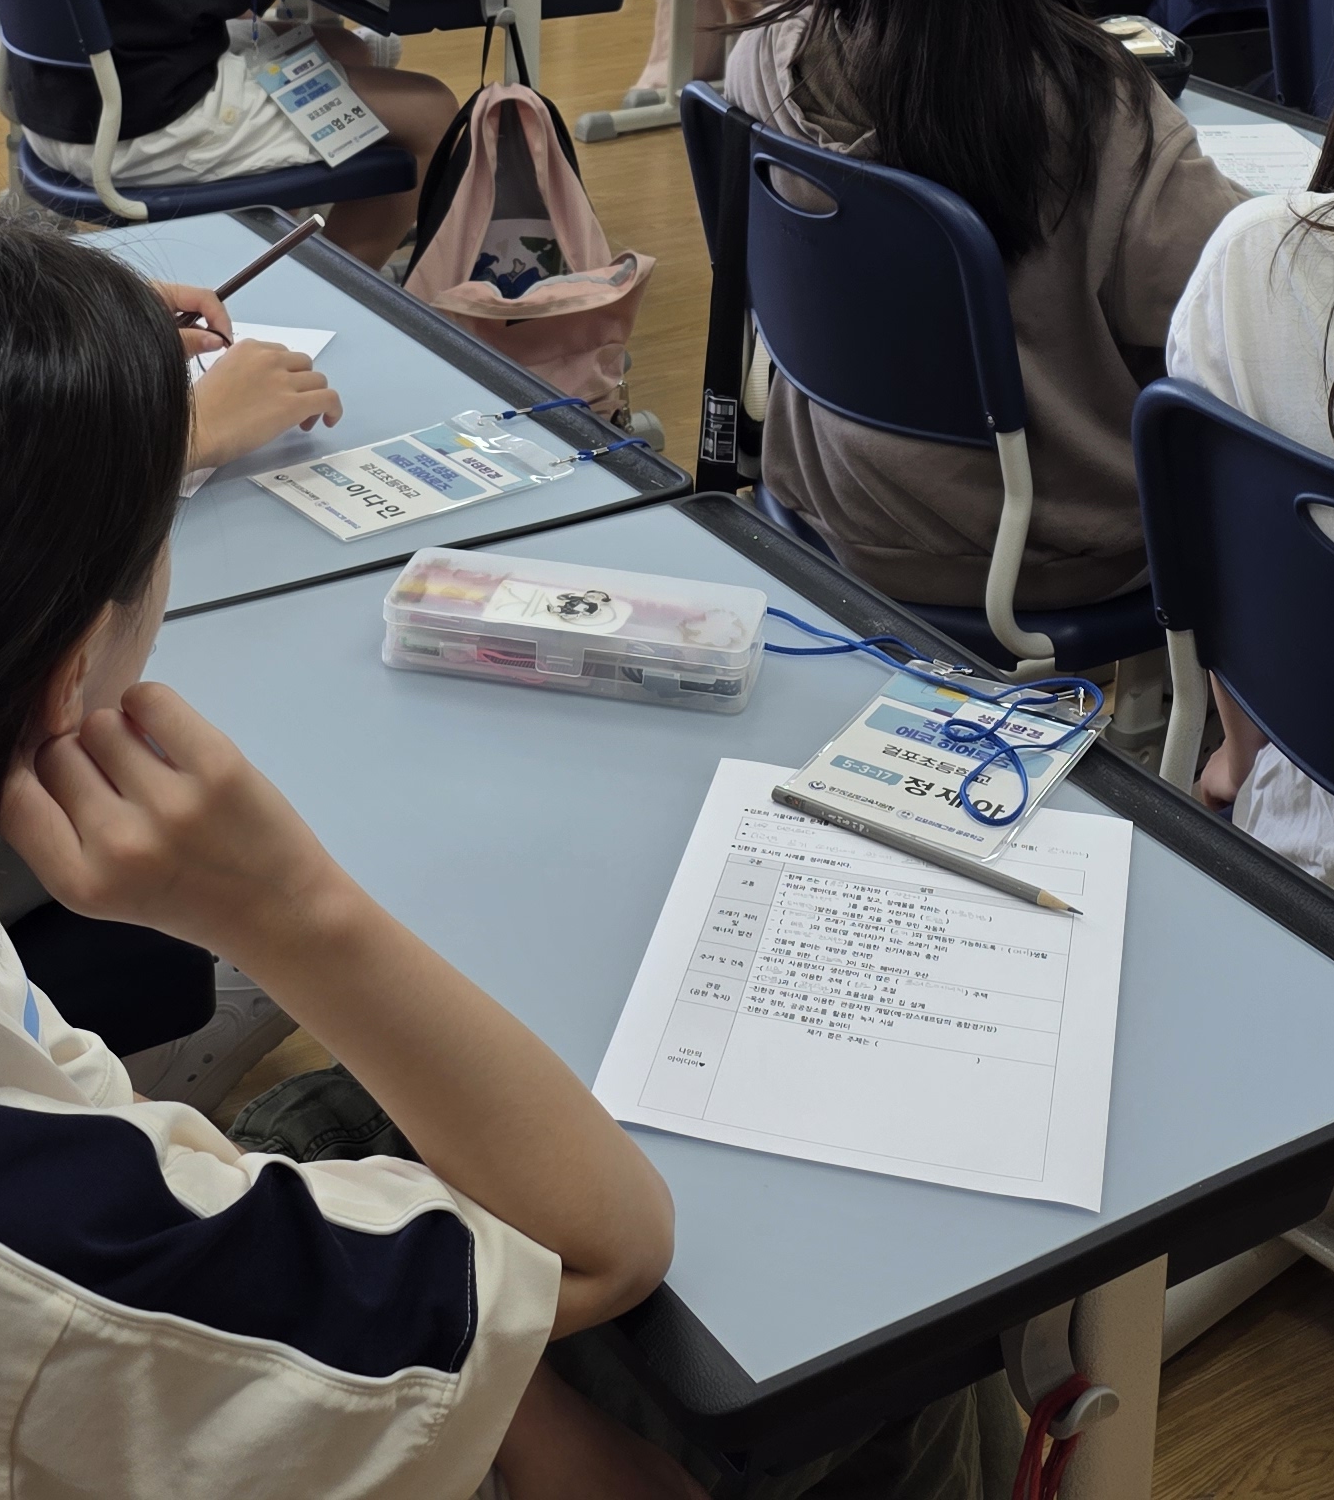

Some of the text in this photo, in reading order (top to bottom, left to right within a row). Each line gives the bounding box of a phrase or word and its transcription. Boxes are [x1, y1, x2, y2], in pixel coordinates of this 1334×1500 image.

[346, 483, 407, 520] 이다인
[895, 725, 936, 745] 에코
[842, 758, 892, 782] 5-3-17
